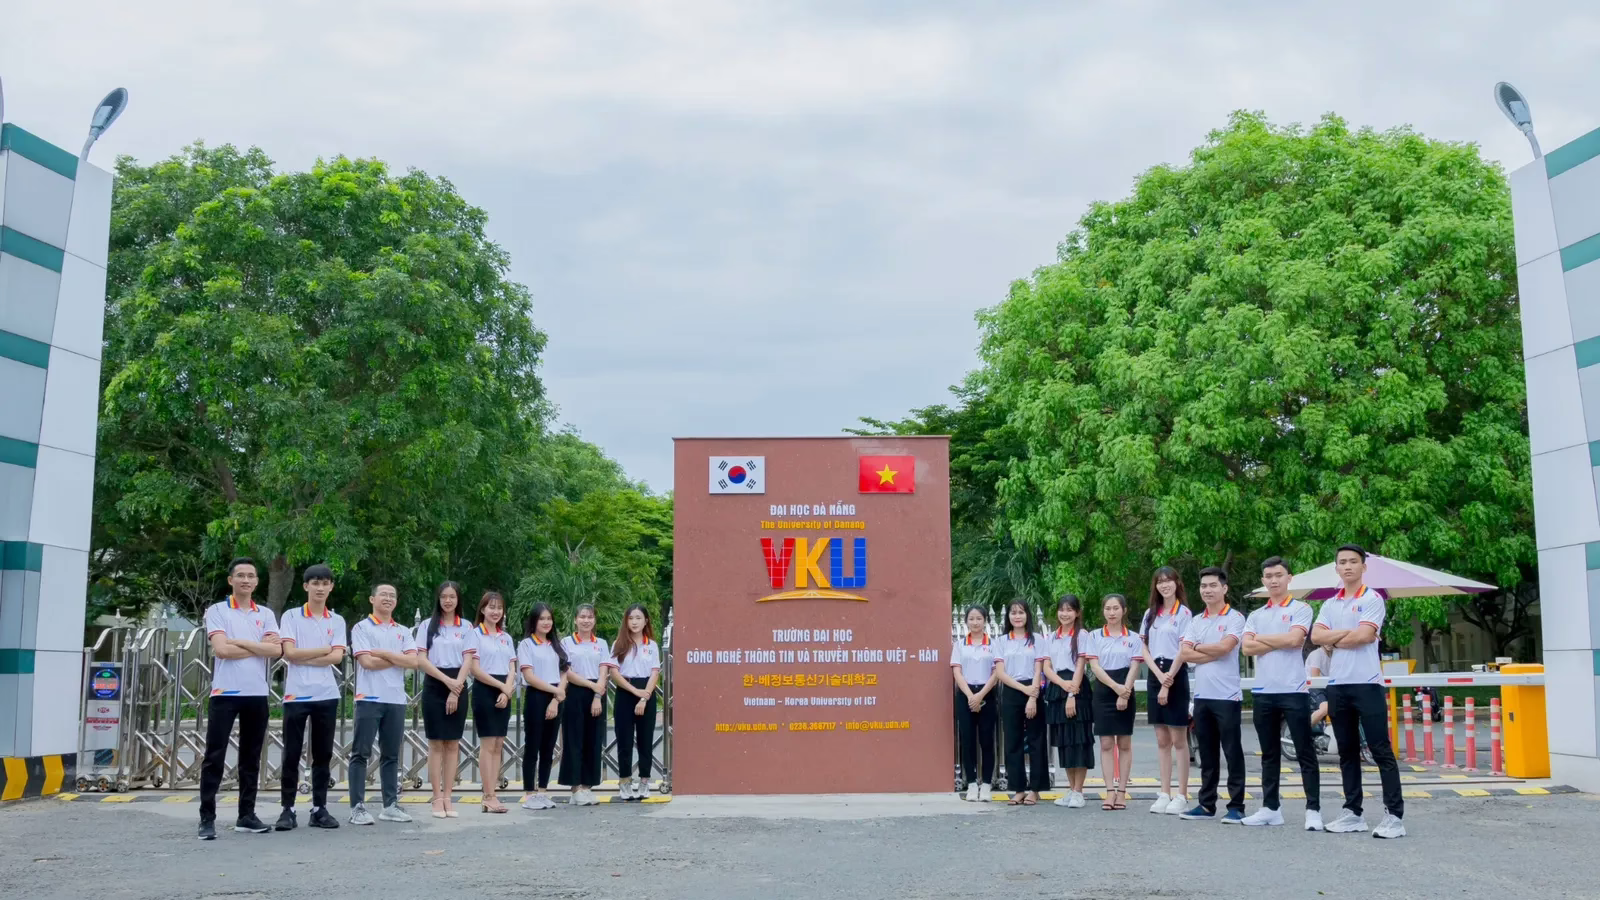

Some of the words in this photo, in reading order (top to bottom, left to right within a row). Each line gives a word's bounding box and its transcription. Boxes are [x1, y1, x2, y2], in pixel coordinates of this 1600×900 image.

[770, 504, 786, 518] ĐẠI
[790, 504, 810, 518] HỌC
[813, 501, 826, 516] ĐÀ
[829, 500, 856, 516] NẴNG
[761, 520, 775, 529] The
[778, 520, 821, 530] University
[824, 520, 832, 529] of
[834, 520, 865, 530] Danang
[760, 537, 867, 589] VKU
[772, 626, 810, 642] TRƯỜNG
[813, 629, 830, 644] ĐẠI
[833, 629, 853, 644] HỌC
[686, 648, 713, 663] CÔNG
[716, 648, 742, 665] NGHỆ
[744, 647, 776, 663] THÔNG
[779, 650, 795, 663] TIN
[797, 647, 810, 663] VÀ
[812, 645, 848, 662] TRUYỀN
[851, 647, 883, 662] THÔNG
[886, 646, 907, 664] VIỆT
[918, 646, 939, 662] HÀN
[743, 696, 776, 706] Vietnam
[784, 697, 809, 706] Korea
[810, 696, 852, 707] University
[854, 696, 863, 706] of
[864, 696, 877, 706] ICT
